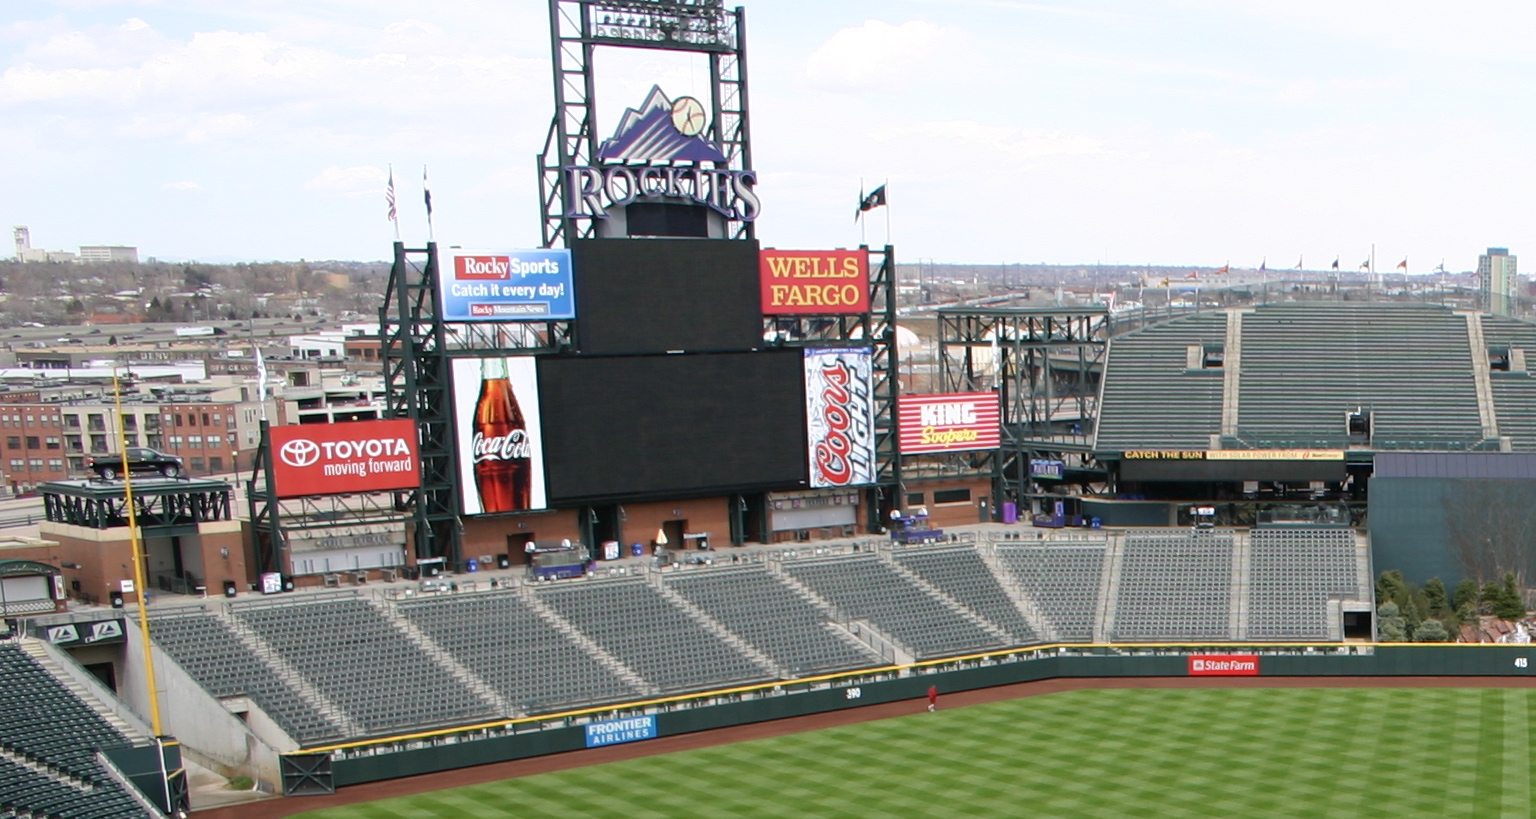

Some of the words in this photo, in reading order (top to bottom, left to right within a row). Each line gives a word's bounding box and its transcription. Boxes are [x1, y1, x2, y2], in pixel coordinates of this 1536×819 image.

[564, 165, 761, 222] ROCKIES
[464, 257, 509, 279] Rocky
[511, 258, 559, 278] Sports
[765, 257, 860, 278] WELLS
[451, 283, 488, 297] Catch
[490, 283, 500, 297] it
[502, 286, 536, 299] every
[539, 283, 565, 299] day!
[769, 284, 860, 306] FARGO
[472, 305, 493, 315] Rocky
[494, 305, 526, 314] Mountain
[816, 360, 852, 485] Coors
[850, 366, 871, 481] LIGHT
[921, 403, 976, 426] KING
[921, 426, 978, 447] Soopers
[321, 438, 410, 459] TOYOTA
[1125, 451, 1159, 459] CATCH
[1161, 451, 1180, 459] THE
[1182, 451, 1203, 459] SUN
[1229, 451, 1252, 459] SOLAR
[1252, 451, 1277, 459] POWER
[324, 460, 367, 477] moving
[368, 457, 412, 474] forward
[1205, 660, 1229, 671] State
[1230, 660, 1255, 671] Farm
[1514, 657, 1528, 668] 415
[846, 687, 861, 700] 390
[589, 717, 652, 736] FRONTIER
[593, 728, 649, 744] AIRLINES
